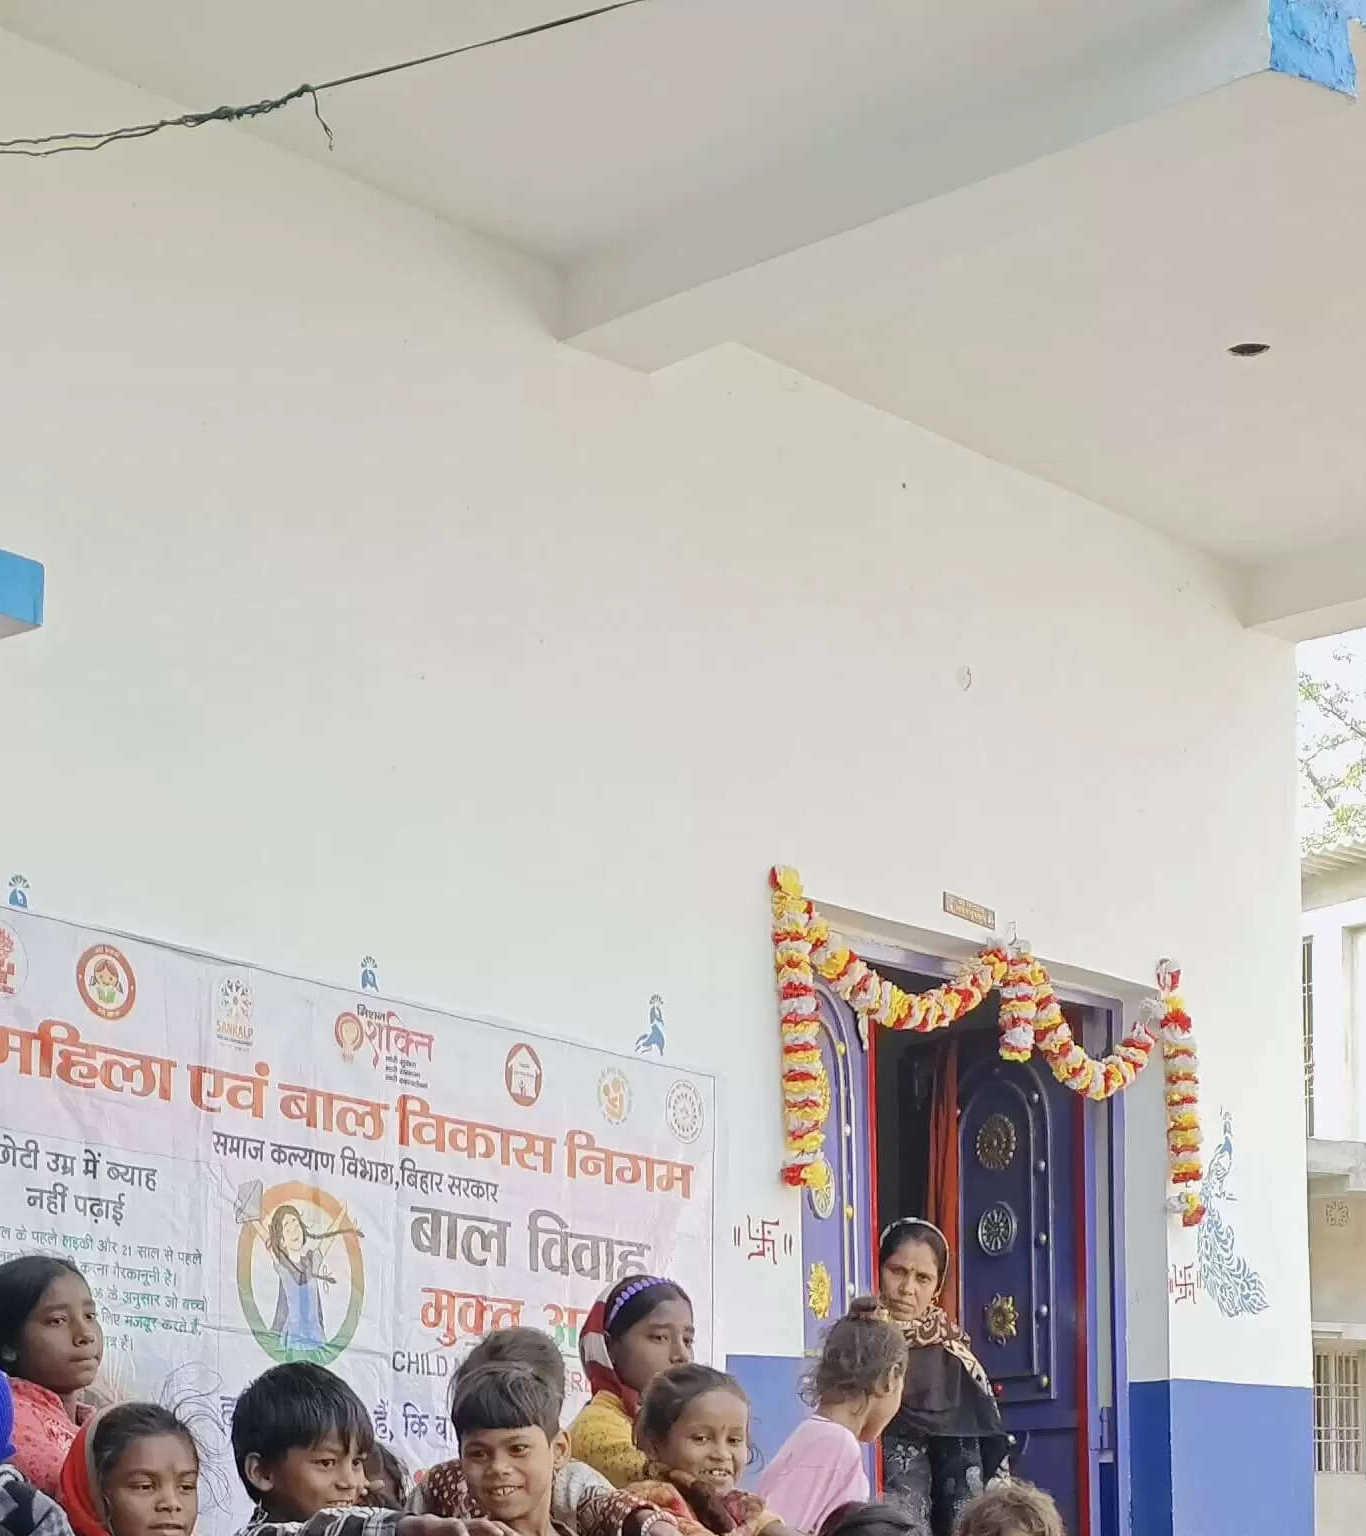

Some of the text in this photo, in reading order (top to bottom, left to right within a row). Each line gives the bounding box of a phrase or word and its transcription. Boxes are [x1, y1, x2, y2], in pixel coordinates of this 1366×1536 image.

[187, 1062, 270, 1119] एवं
[278, 1084, 390, 1141] बाल
[395, 1094, 557, 1174] विकास
[564, 1130, 694, 1200] निगम
[46, 1152, 76, 1177] उम्र
[83, 1149, 102, 1179] में
[106, 1161, 157, 1191] ब्याह
[212, 1131, 265, 1162] समाज
[270, 1142, 336, 1175] कल्याण
[448, 1177, 499, 1203] सरकार
[26, 1182, 68, 1215] नहीं
[15, 1225, 27, 1240] के
[32, 1228, 58, 1246] पहले
[98, 1238, 117, 1254] और
[137, 1245, 159, 1259] साल
[163, 1246, 173, 1263] से
[178, 1249, 202, 1265] पहले
[411, 1206, 651, 1282] बाल विवाह
[123, 1292, 160, 1309] अनुसार
[392, 1351, 448, 1377] CHILD
[403, 1402, 429, 1440] कि
